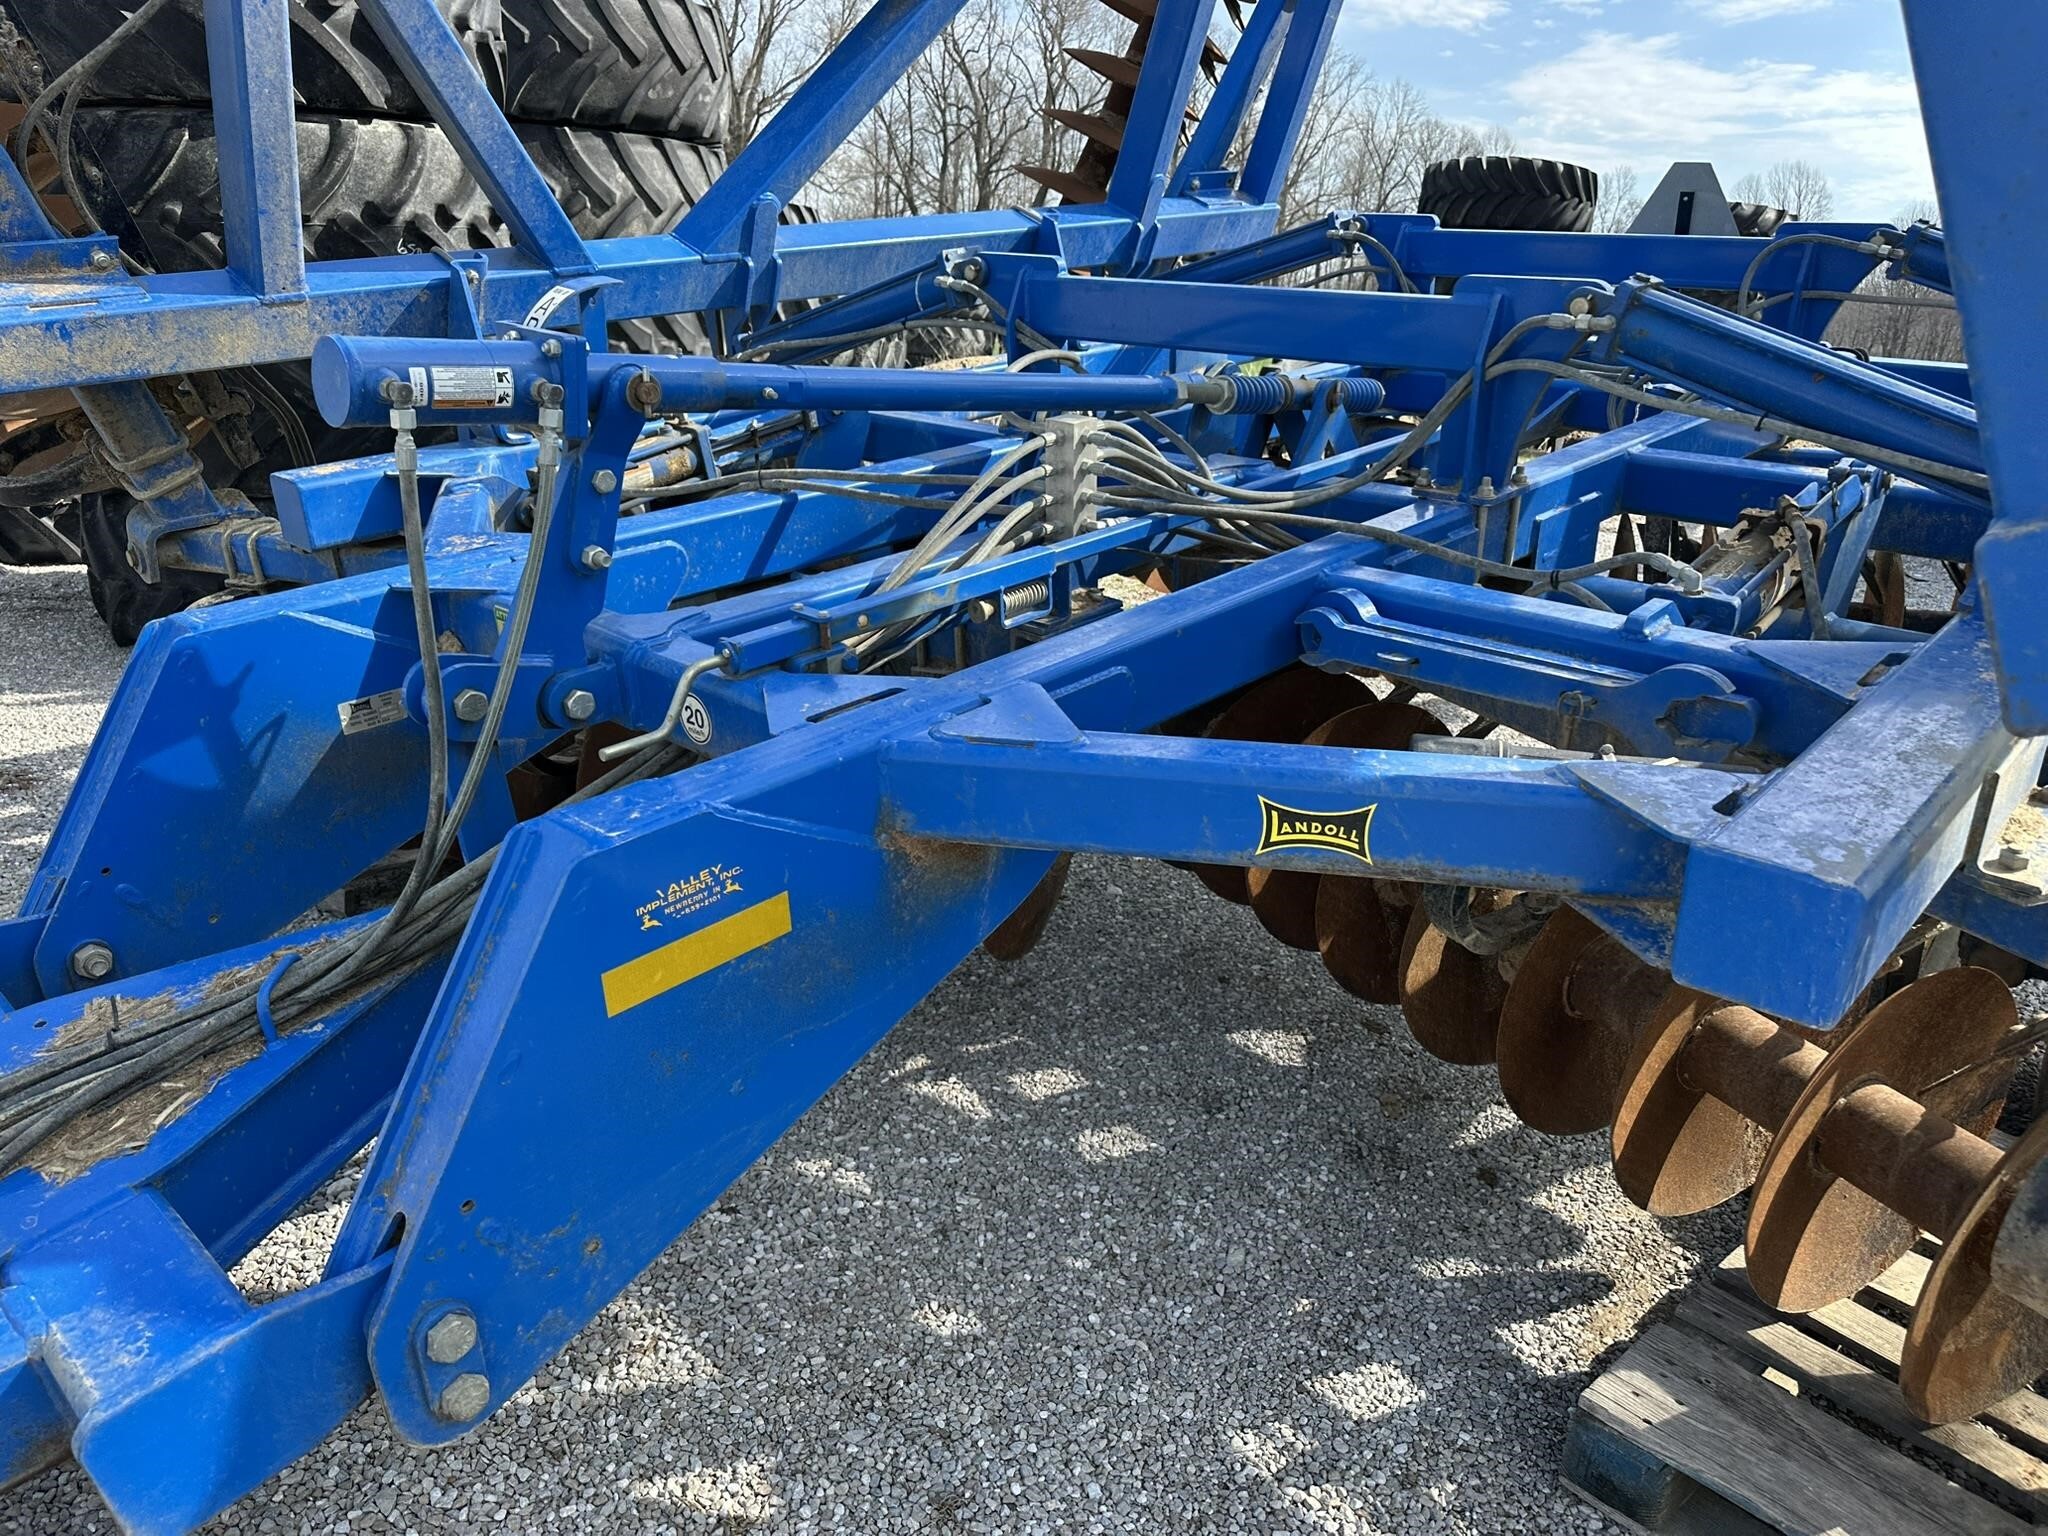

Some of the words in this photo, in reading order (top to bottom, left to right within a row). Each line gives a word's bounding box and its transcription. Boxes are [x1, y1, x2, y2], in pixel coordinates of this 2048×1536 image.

[684, 704, 705, 730] 20
[1269, 809, 1360, 850] LANDOLL
[635, 877, 716, 917] IMPLEMENT,
[719, 866, 744, 881] INC.
